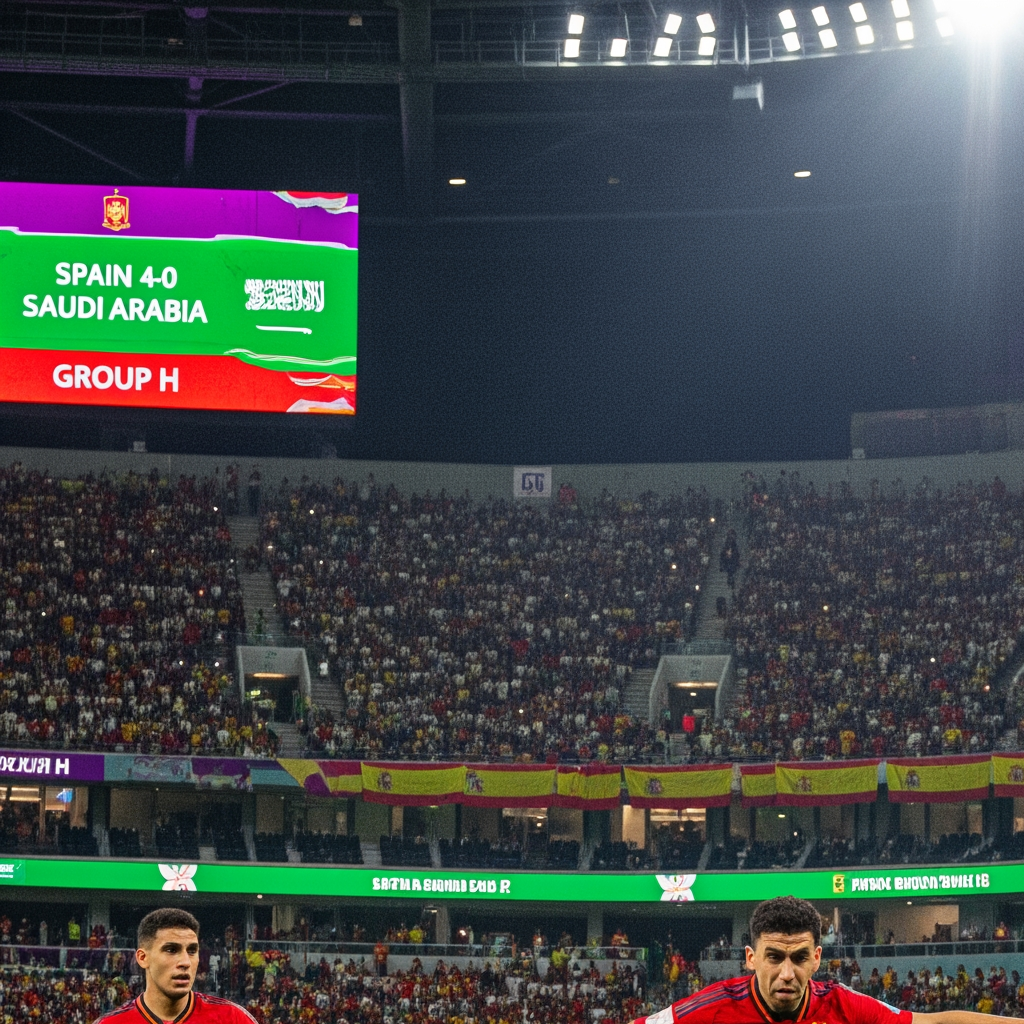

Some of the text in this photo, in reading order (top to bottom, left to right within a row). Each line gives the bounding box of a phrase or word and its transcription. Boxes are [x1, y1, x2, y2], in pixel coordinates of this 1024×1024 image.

[55, 262, 178, 289] SPAIN 4-0
[22, 294, 208, 323] SAUDI ARABIA
[52, 364, 179, 392] GROUP H
